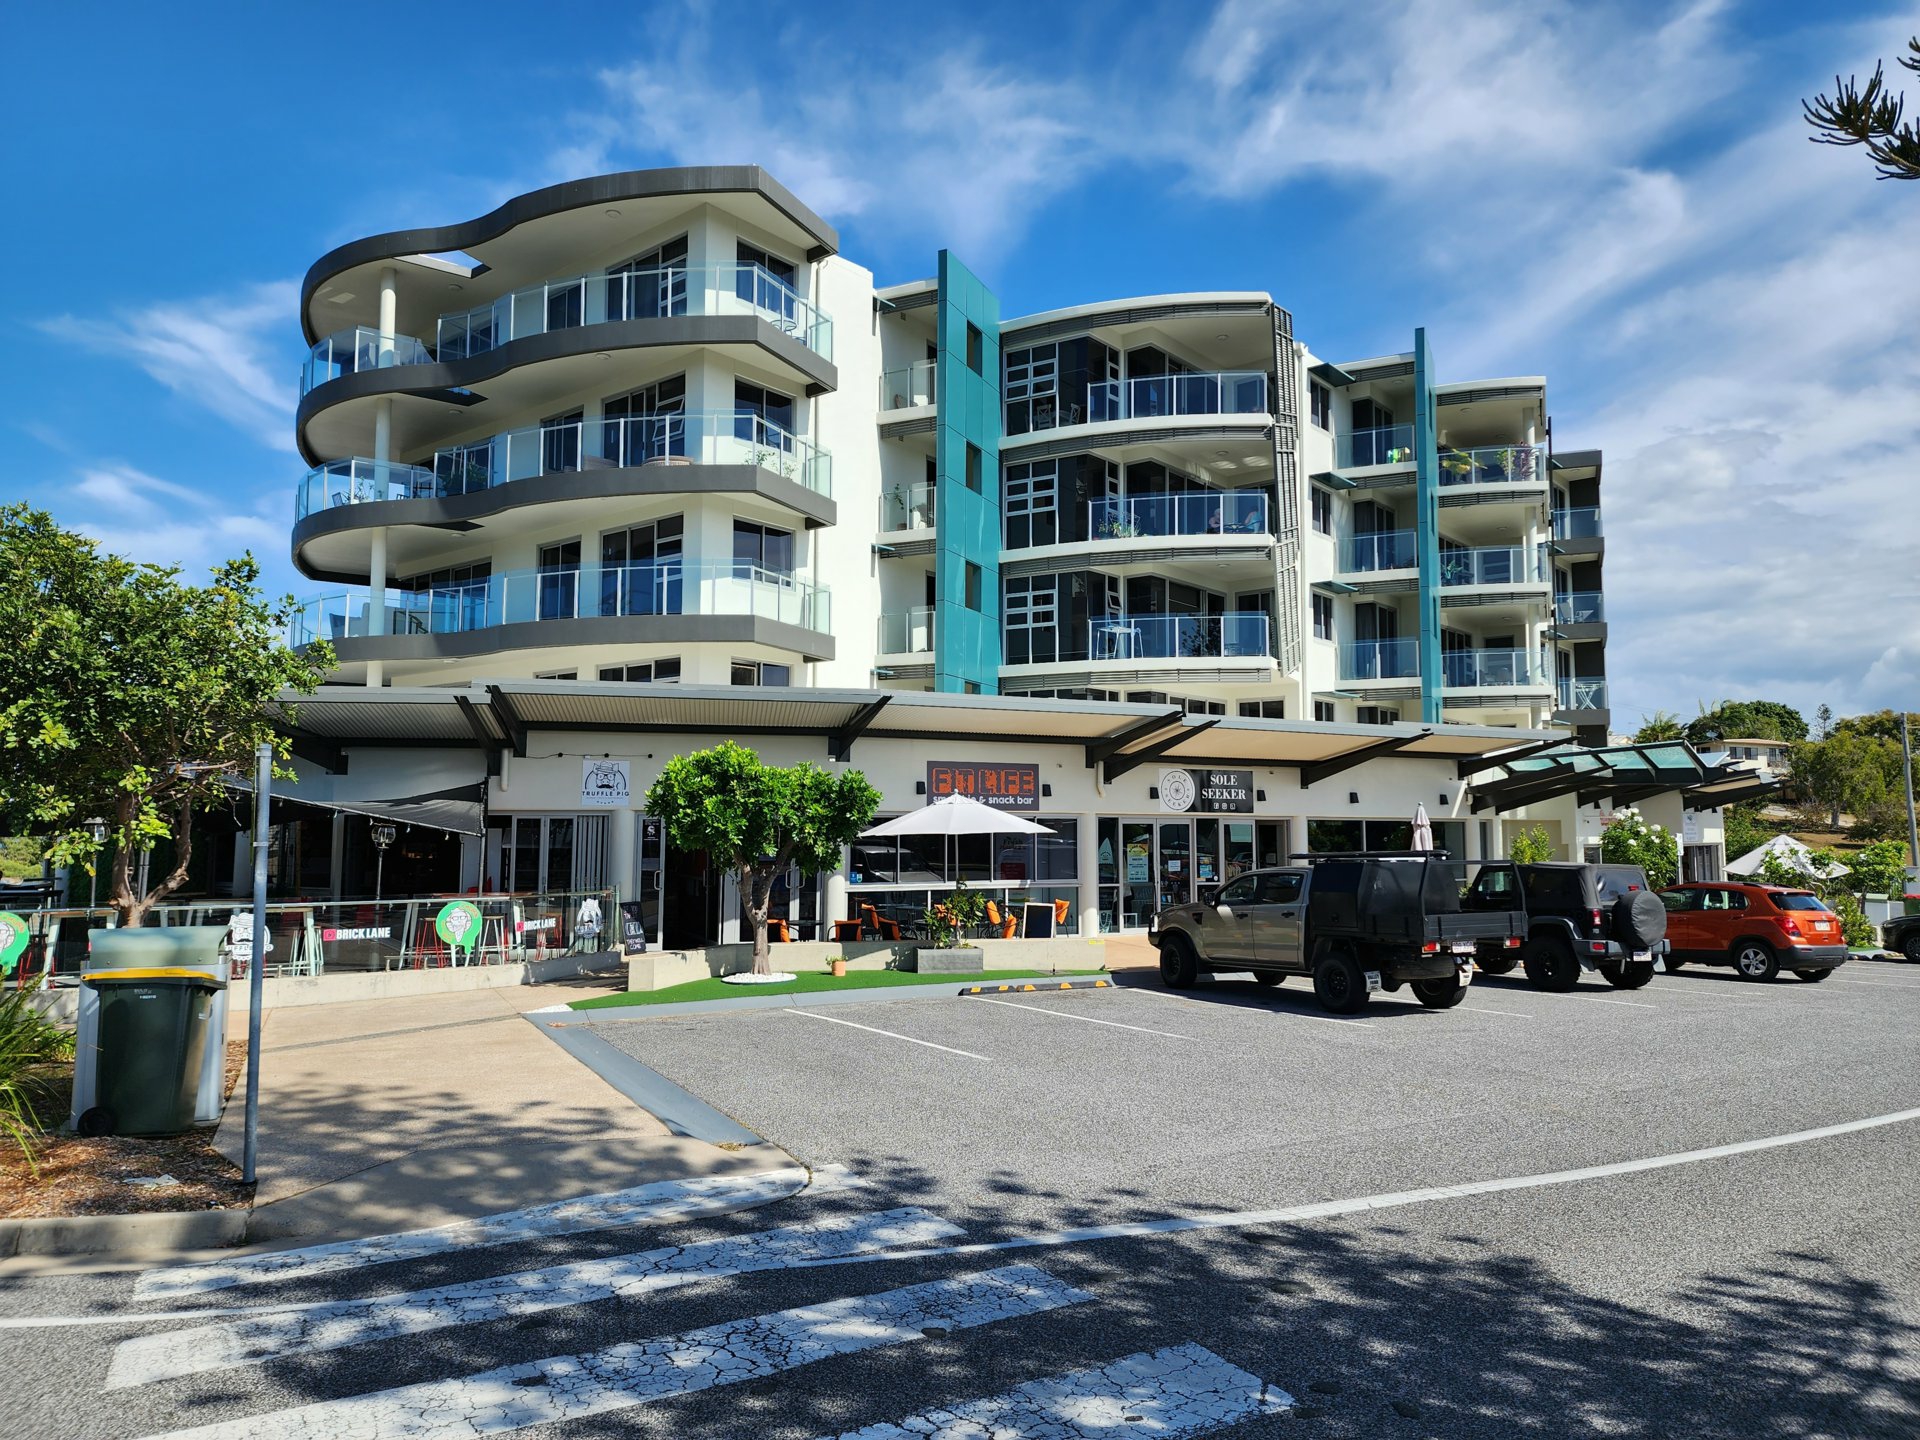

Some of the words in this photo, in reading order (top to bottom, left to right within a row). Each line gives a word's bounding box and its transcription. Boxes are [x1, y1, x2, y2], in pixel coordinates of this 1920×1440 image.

[1210, 774, 1238, 786] SOLE
[988, 795, 1016, 805] snack
[1017, 795, 1034, 805] bar
[1201, 788, 1246, 800] SEEKER
[524, 920, 541, 931] BRICK
[541, 917, 556, 929] LANE
[336, 928, 365, 940] BRICK
[366, 927, 391, 938] LANE
